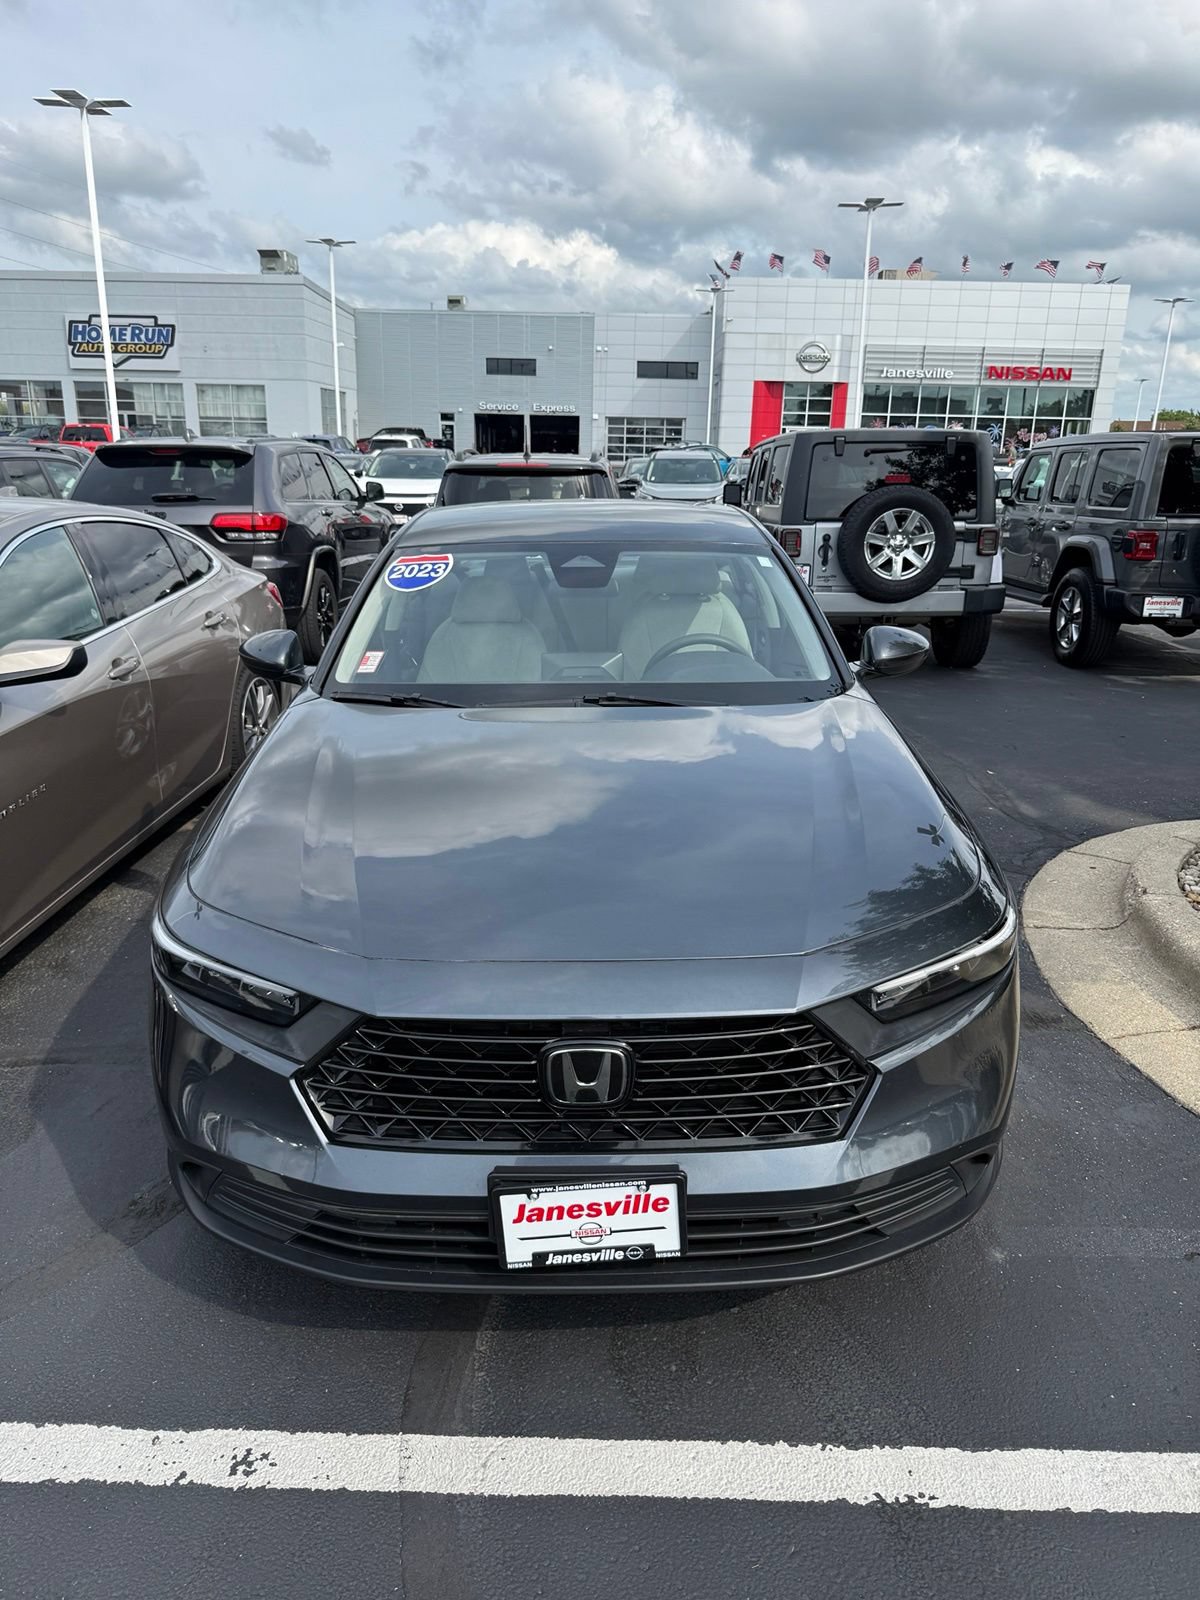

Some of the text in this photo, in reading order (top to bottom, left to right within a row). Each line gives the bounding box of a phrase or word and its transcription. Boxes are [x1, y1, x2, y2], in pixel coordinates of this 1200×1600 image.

[117, 344, 164, 354] GROUP
[880, 365, 1073, 382] Janesville NISSAN
[479, 401, 576, 413] Service Express
[388, 563, 447, 579] 2023
[531, 1180, 646, 1193] www.janesvillenissan.com
[512, 1193, 670, 1224] Janesville
[574, 1227, 607, 1237] NISSAN
[546, 1248, 625, 1265] Janesville
[507, 1261, 533, 1269] NISSAN
